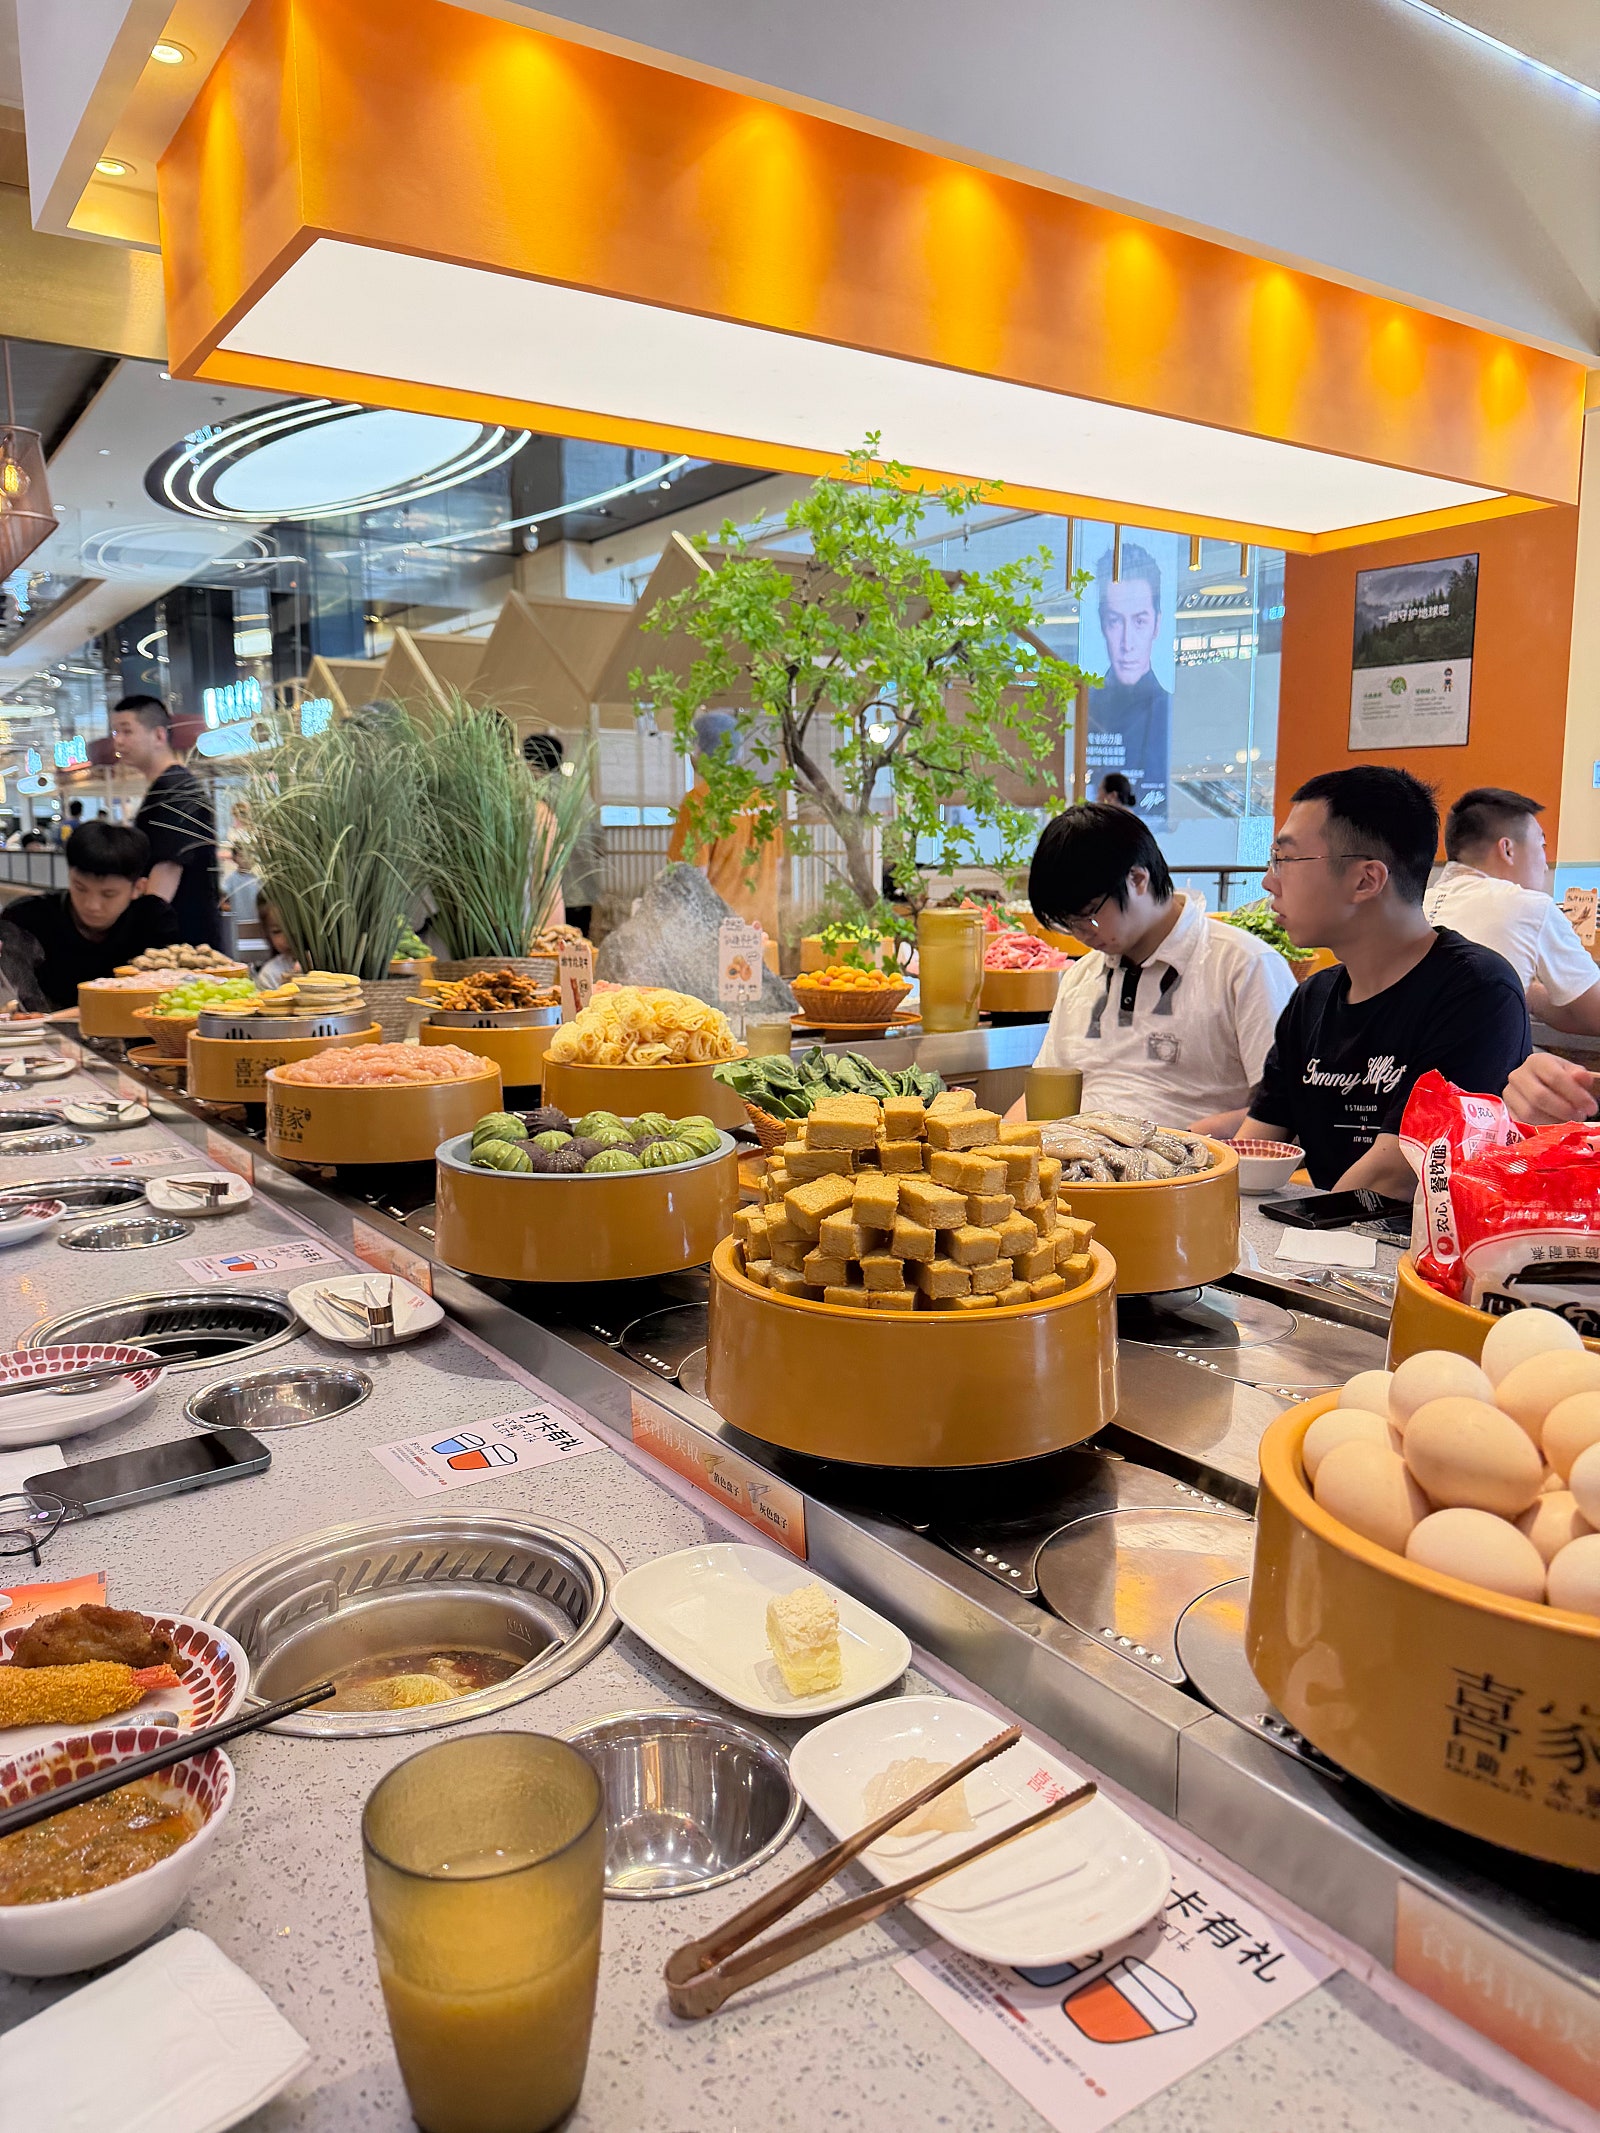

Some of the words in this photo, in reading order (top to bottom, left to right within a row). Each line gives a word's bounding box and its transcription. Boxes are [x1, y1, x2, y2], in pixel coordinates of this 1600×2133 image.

[1378, 604, 1450, 623] 一起守护地球吧
[1429, 1144, 1448, 1193] 餐饮面
[1435, 1201, 1449, 1232] 农心
[1531, 1245, 1600, 1261] 筋道耐煮
[519, 1411, 584, 1452] 打卡有礼
[713, 1472, 740, 1497] 黄色盘子
[759, 1502, 788, 1529] 灰色盘子
[1165, 1876, 1285, 1983] 卡有礼
